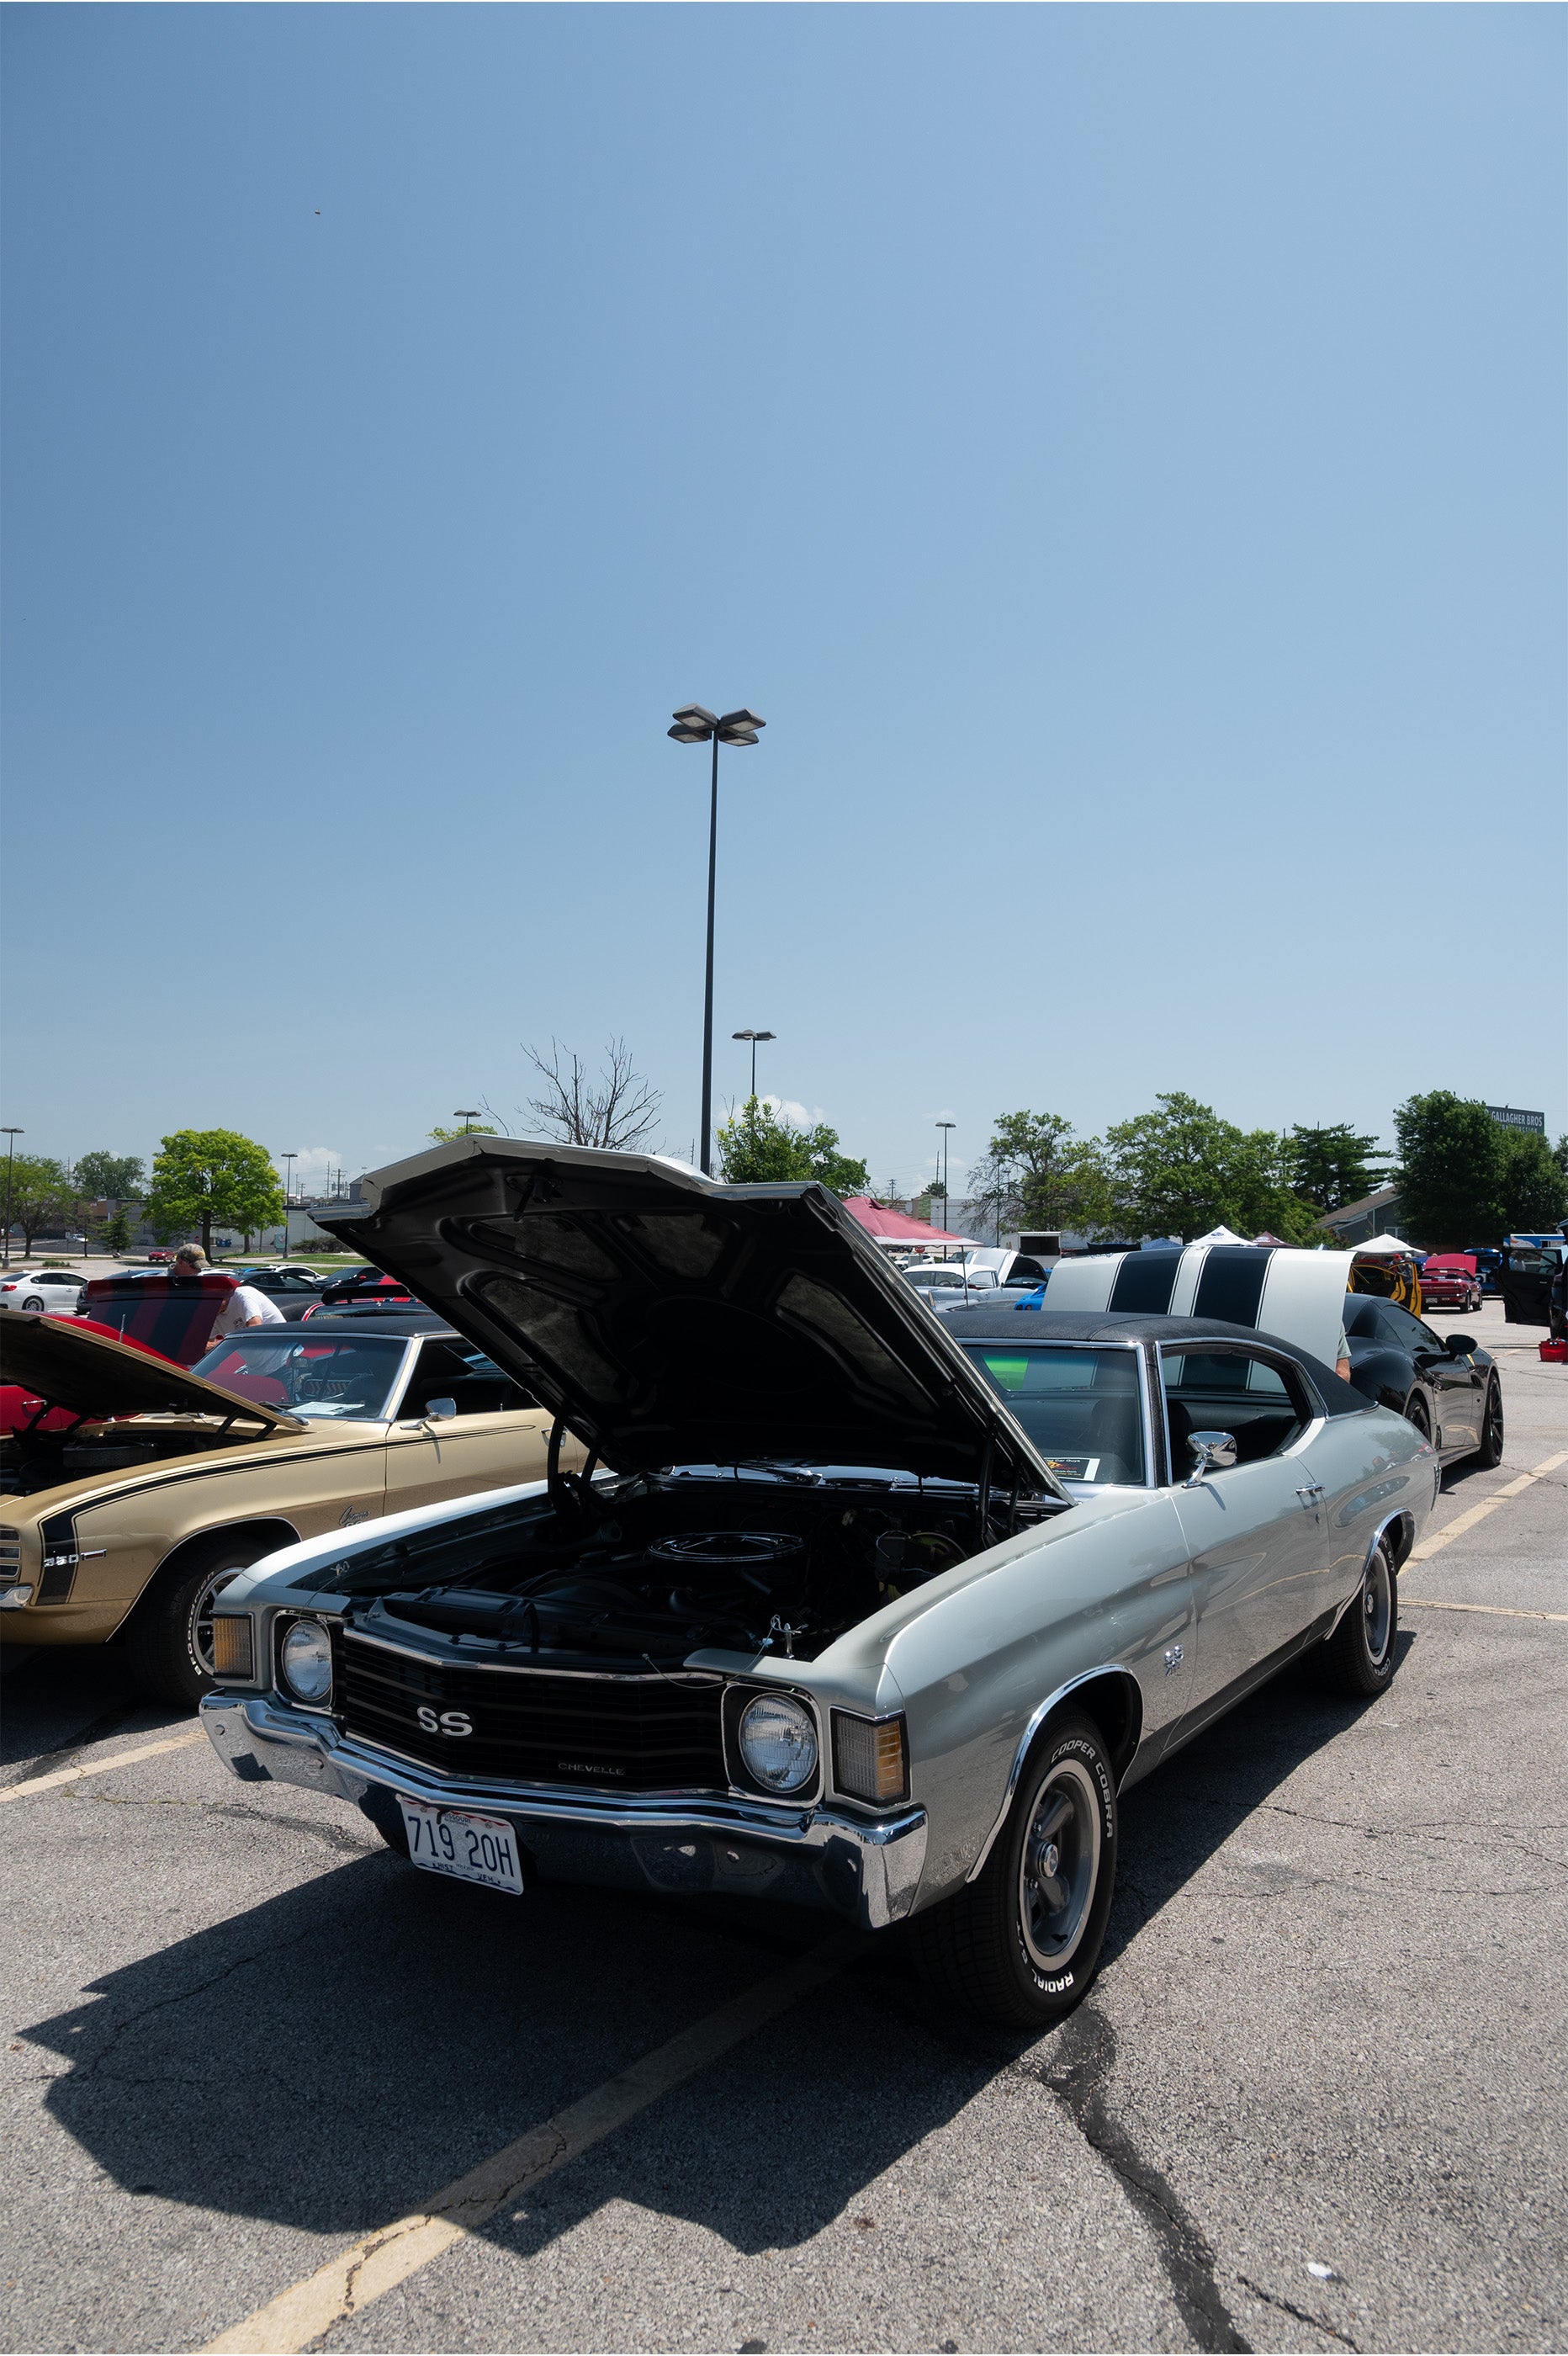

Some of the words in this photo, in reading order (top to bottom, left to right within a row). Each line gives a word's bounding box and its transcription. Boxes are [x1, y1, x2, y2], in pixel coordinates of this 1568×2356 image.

[1491, 1111, 1525, 1125] GALLAGHER
[1527, 1115, 1543, 1127] BROS
[44, 1553, 79, 1568] 350
[1164, 1643, 1184, 1669] SS
[416, 1706, 473, 1737] SS
[1051, 1739, 1096, 1764] COOPER
[558, 1763, 625, 1775] CHEVELLE
[1095, 1761, 1113, 1838] COBRA
[408, 1816, 455, 1861] 719
[465, 1829, 515, 1878] 20H
[437, 1862, 453, 1871] HIST
[477, 1873, 493, 1882] VEH
[1031, 1968, 1074, 1993] RADIAL
